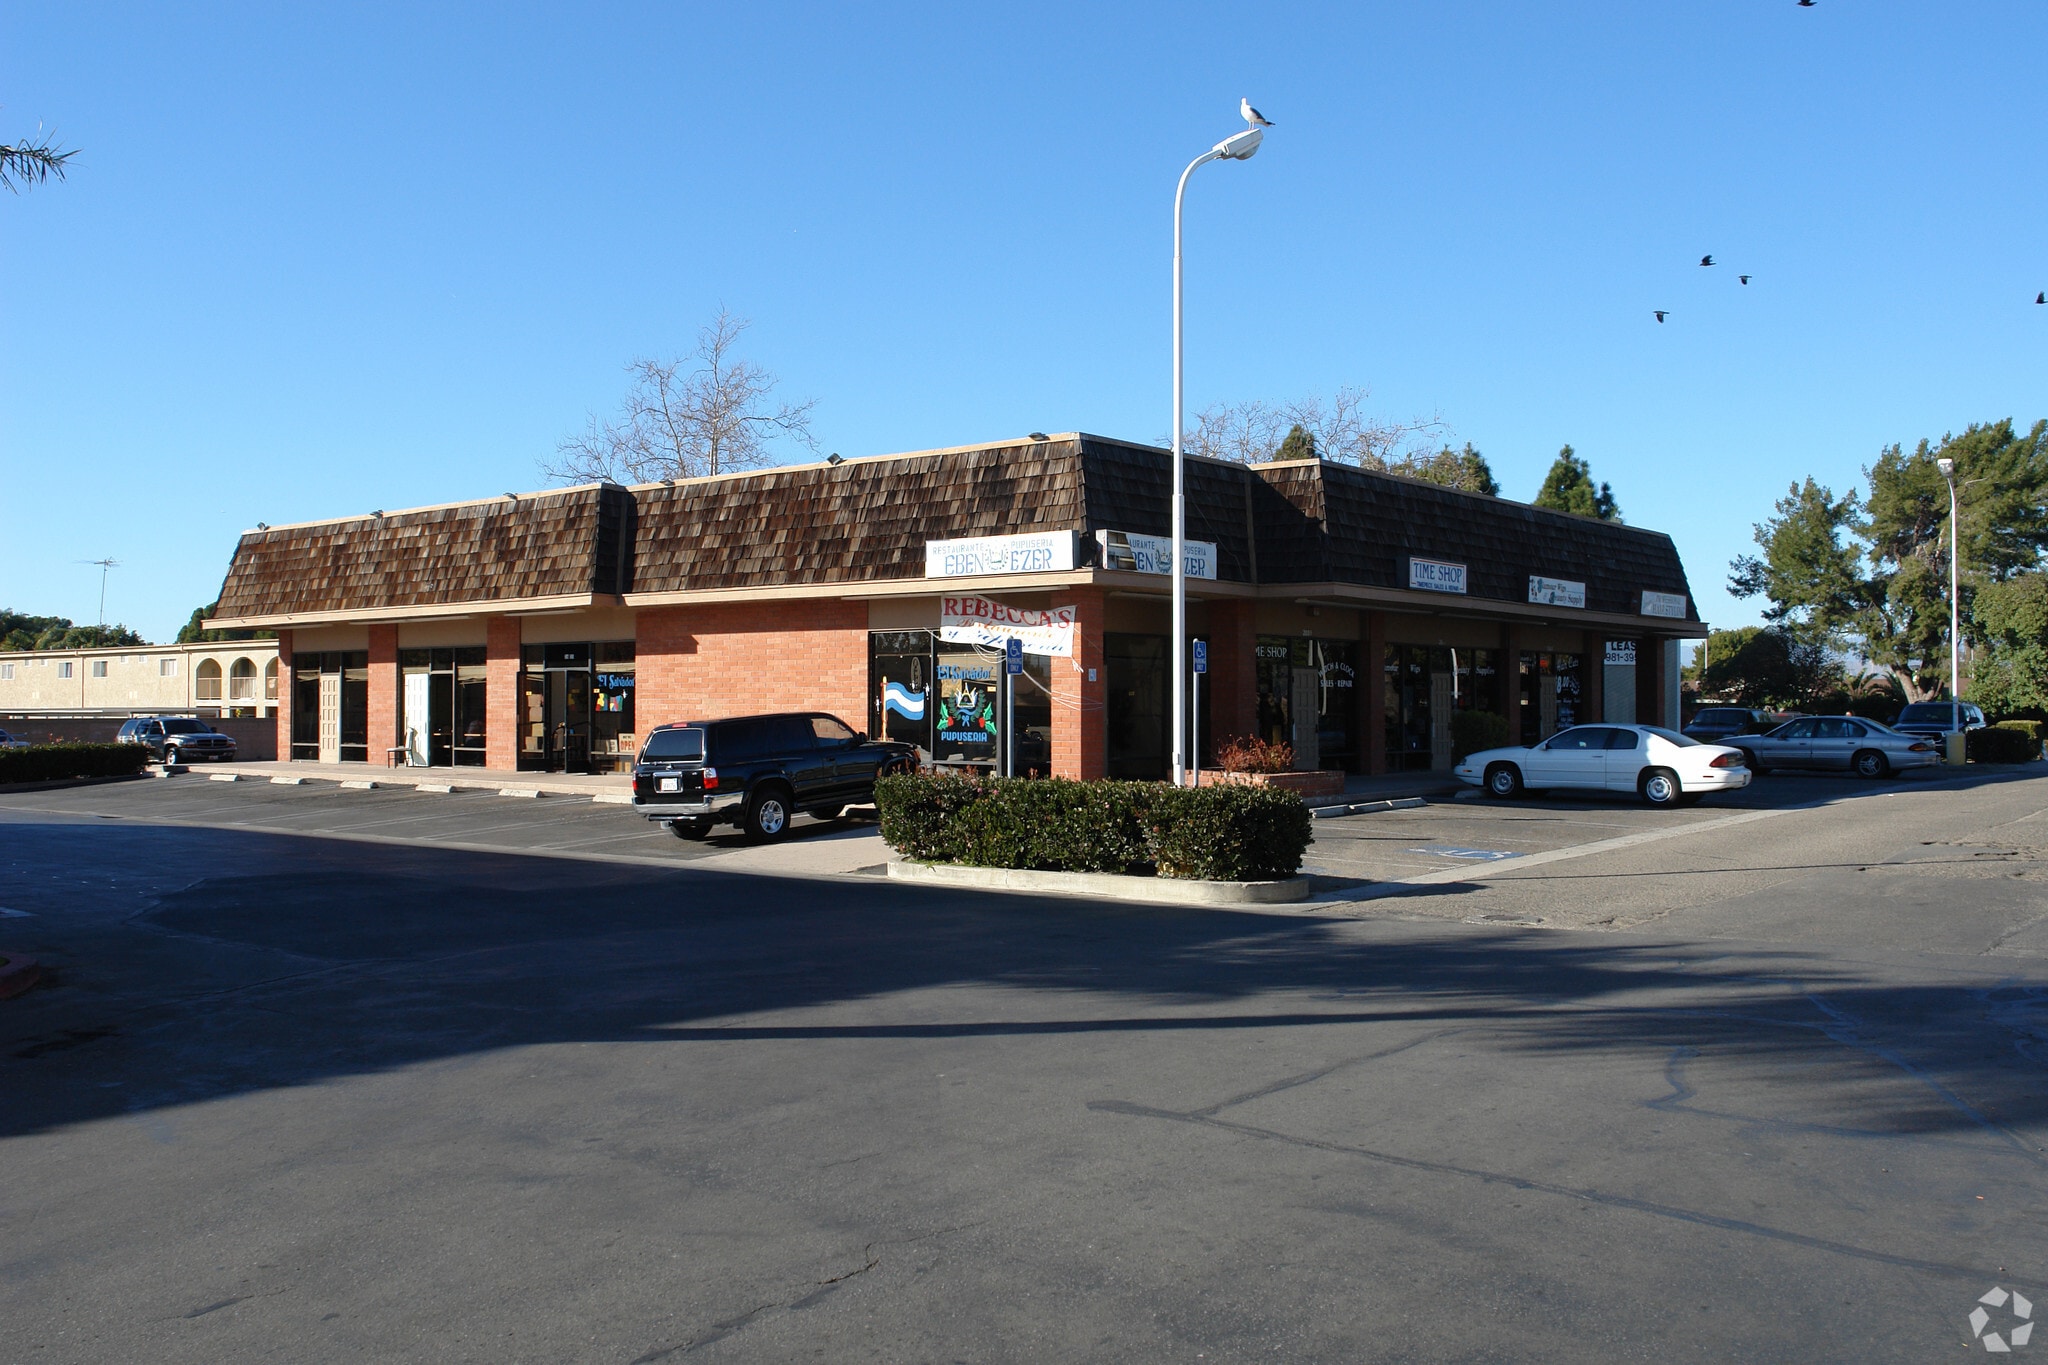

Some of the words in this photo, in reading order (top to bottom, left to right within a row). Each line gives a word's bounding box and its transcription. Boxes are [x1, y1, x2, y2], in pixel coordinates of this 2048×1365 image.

[932, 542, 985, 555] RESTAURANTE
[1011, 539, 1054, 549] PUPUSERIA
[945, 552, 985, 575] EBEN
[1010, 548, 1052, 571] EZER
[1413, 562, 1435, 579] TIME
[1438, 566, 1462, 583] SHOP
[944, 597, 1071, 628] REBECCA'S
[1266, 647, 1288, 658] SHOP
[937, 665, 950, 680] El
[951, 665, 994, 684] Salvador
[1339, 662, 1356, 679] CLOCK
[941, 731, 988, 742] PUPUSERIA
